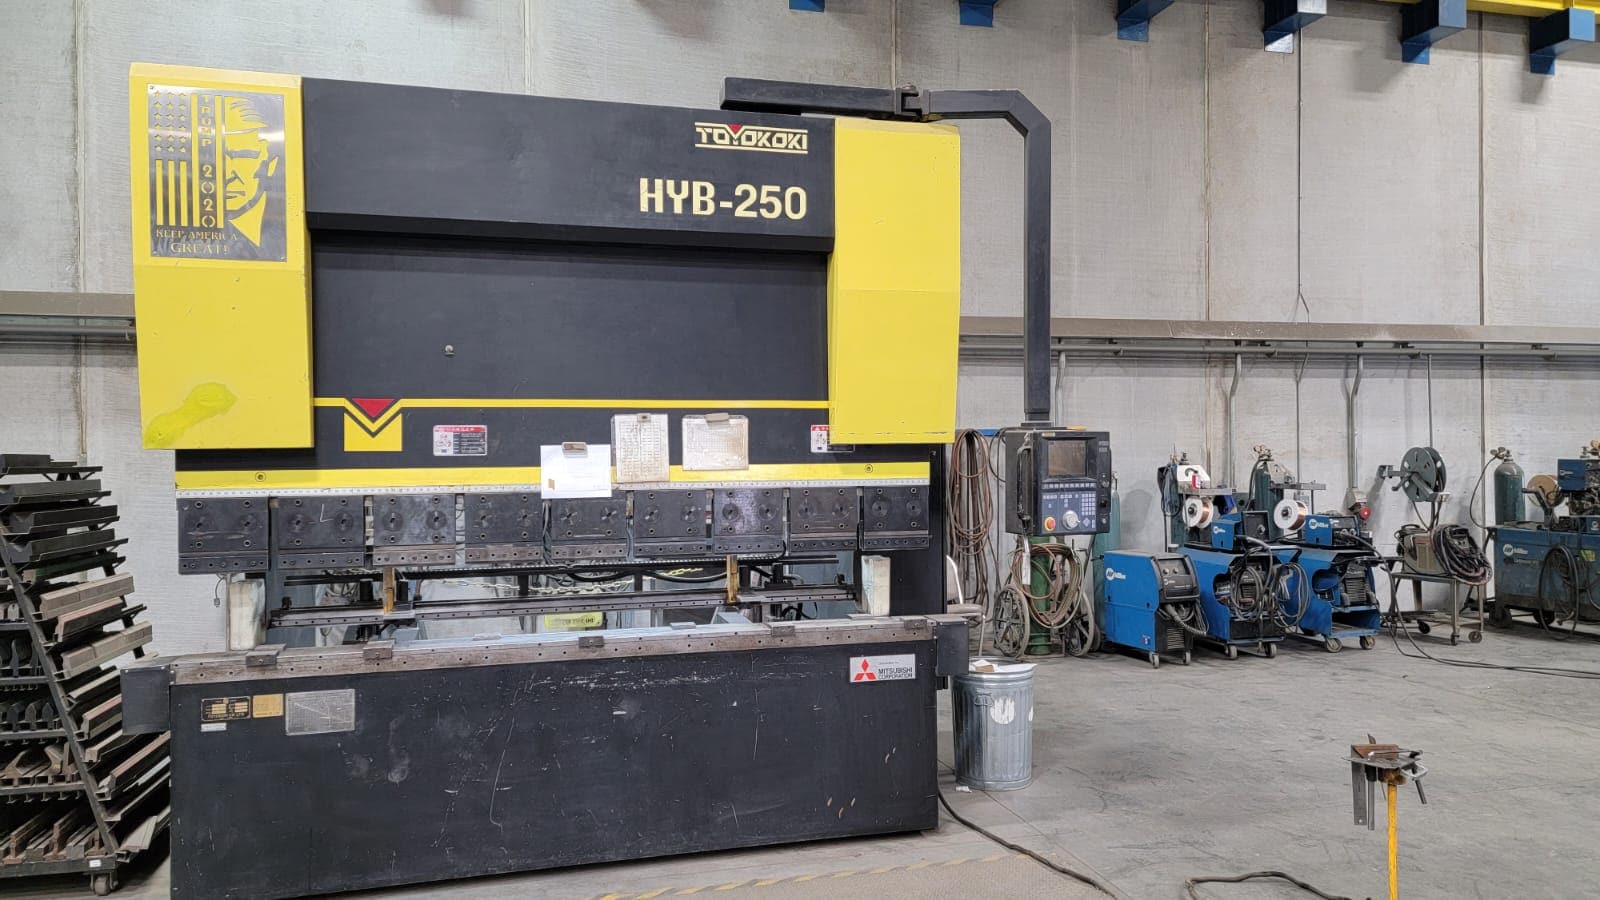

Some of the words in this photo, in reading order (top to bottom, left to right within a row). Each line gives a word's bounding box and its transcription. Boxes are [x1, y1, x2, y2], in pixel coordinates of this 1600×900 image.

[200, 94, 213, 147] TRUMP
[695, 124, 808, 151] TOYOKOKI
[201, 164, 216, 228] 2020
[639, 177, 807, 220] HYB-250
[156, 229, 184, 239] KEEP
[188, 231, 238, 241] AMERICA
[878, 667, 913, 676] MITSUBISHI
